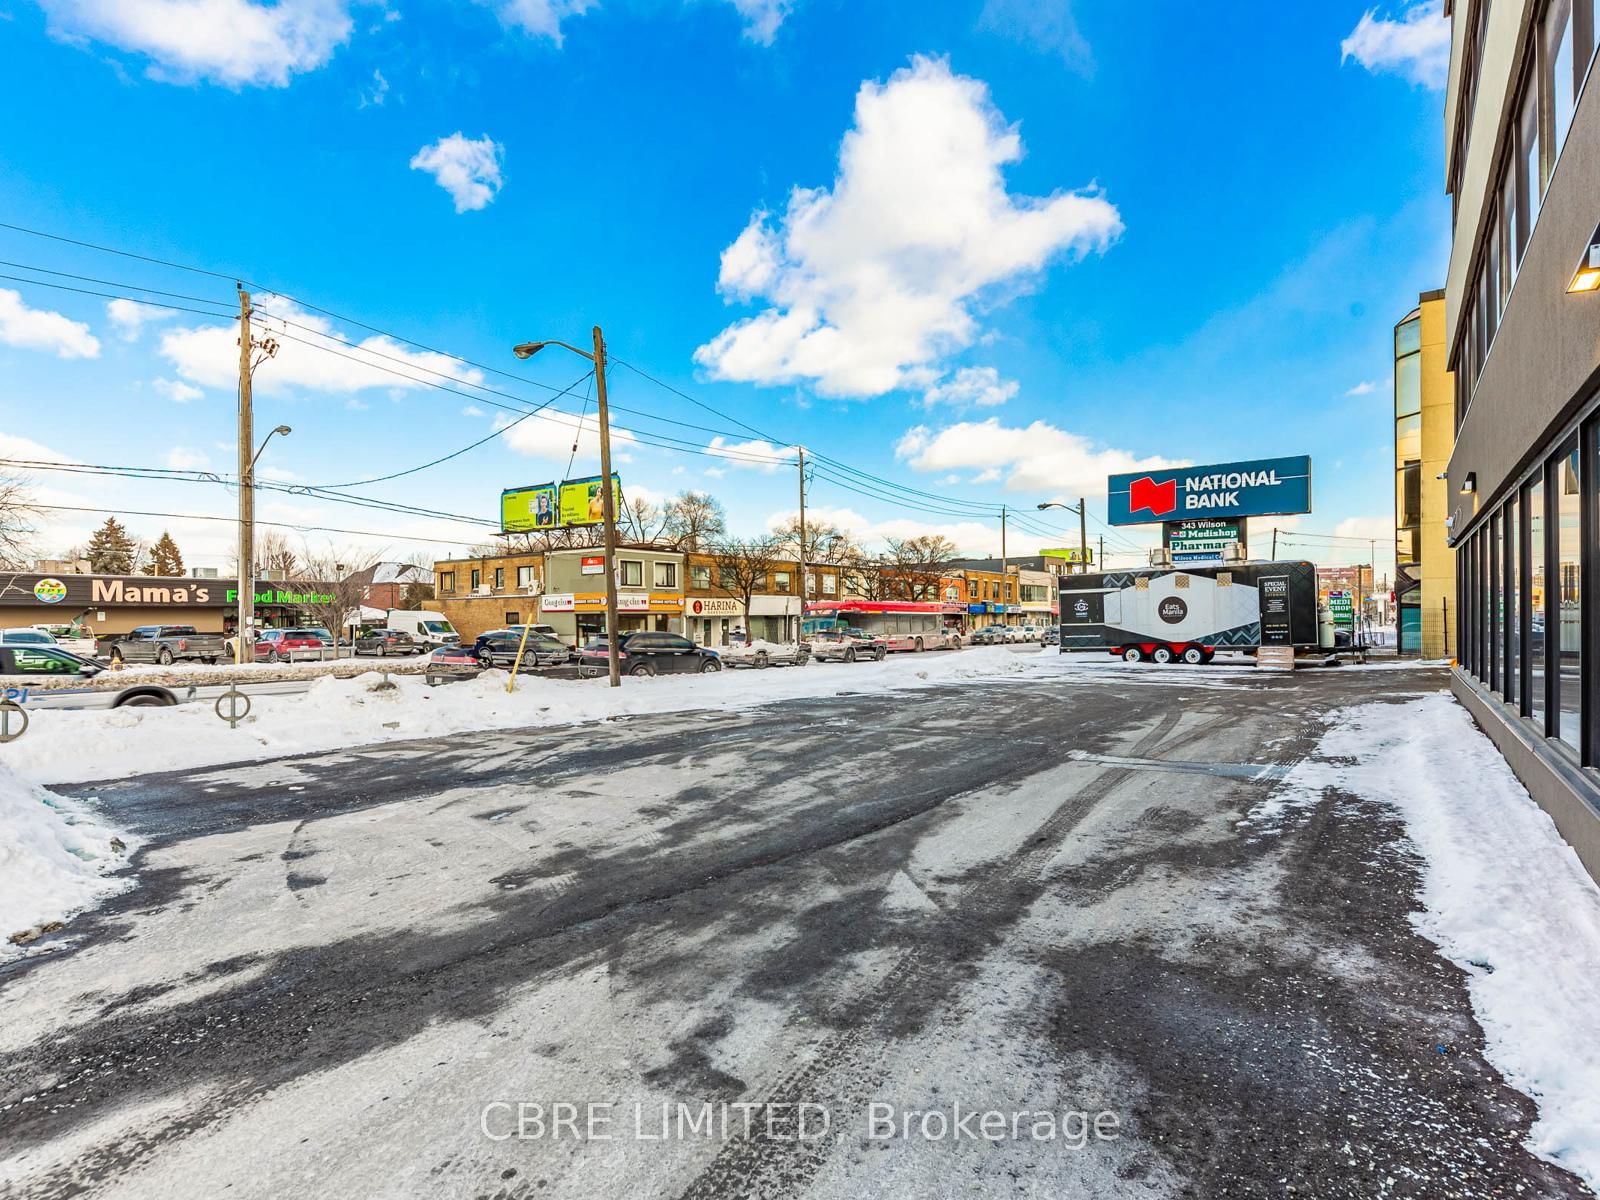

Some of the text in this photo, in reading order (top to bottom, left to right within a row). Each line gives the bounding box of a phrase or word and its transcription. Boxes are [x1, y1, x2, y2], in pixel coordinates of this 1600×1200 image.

[1185, 469, 1282, 492] NATIONAL
[1185, 490, 1240, 510] BANK
[1181, 521, 1227, 530] 343 Wilson
[1187, 529, 1237, 539] Medishop
[91, 579, 210, 603] Mama's
[226, 589, 273, 604] Fod
[703, 600, 737, 611] HARINA
[1162, 608, 1184, 616] Manila
